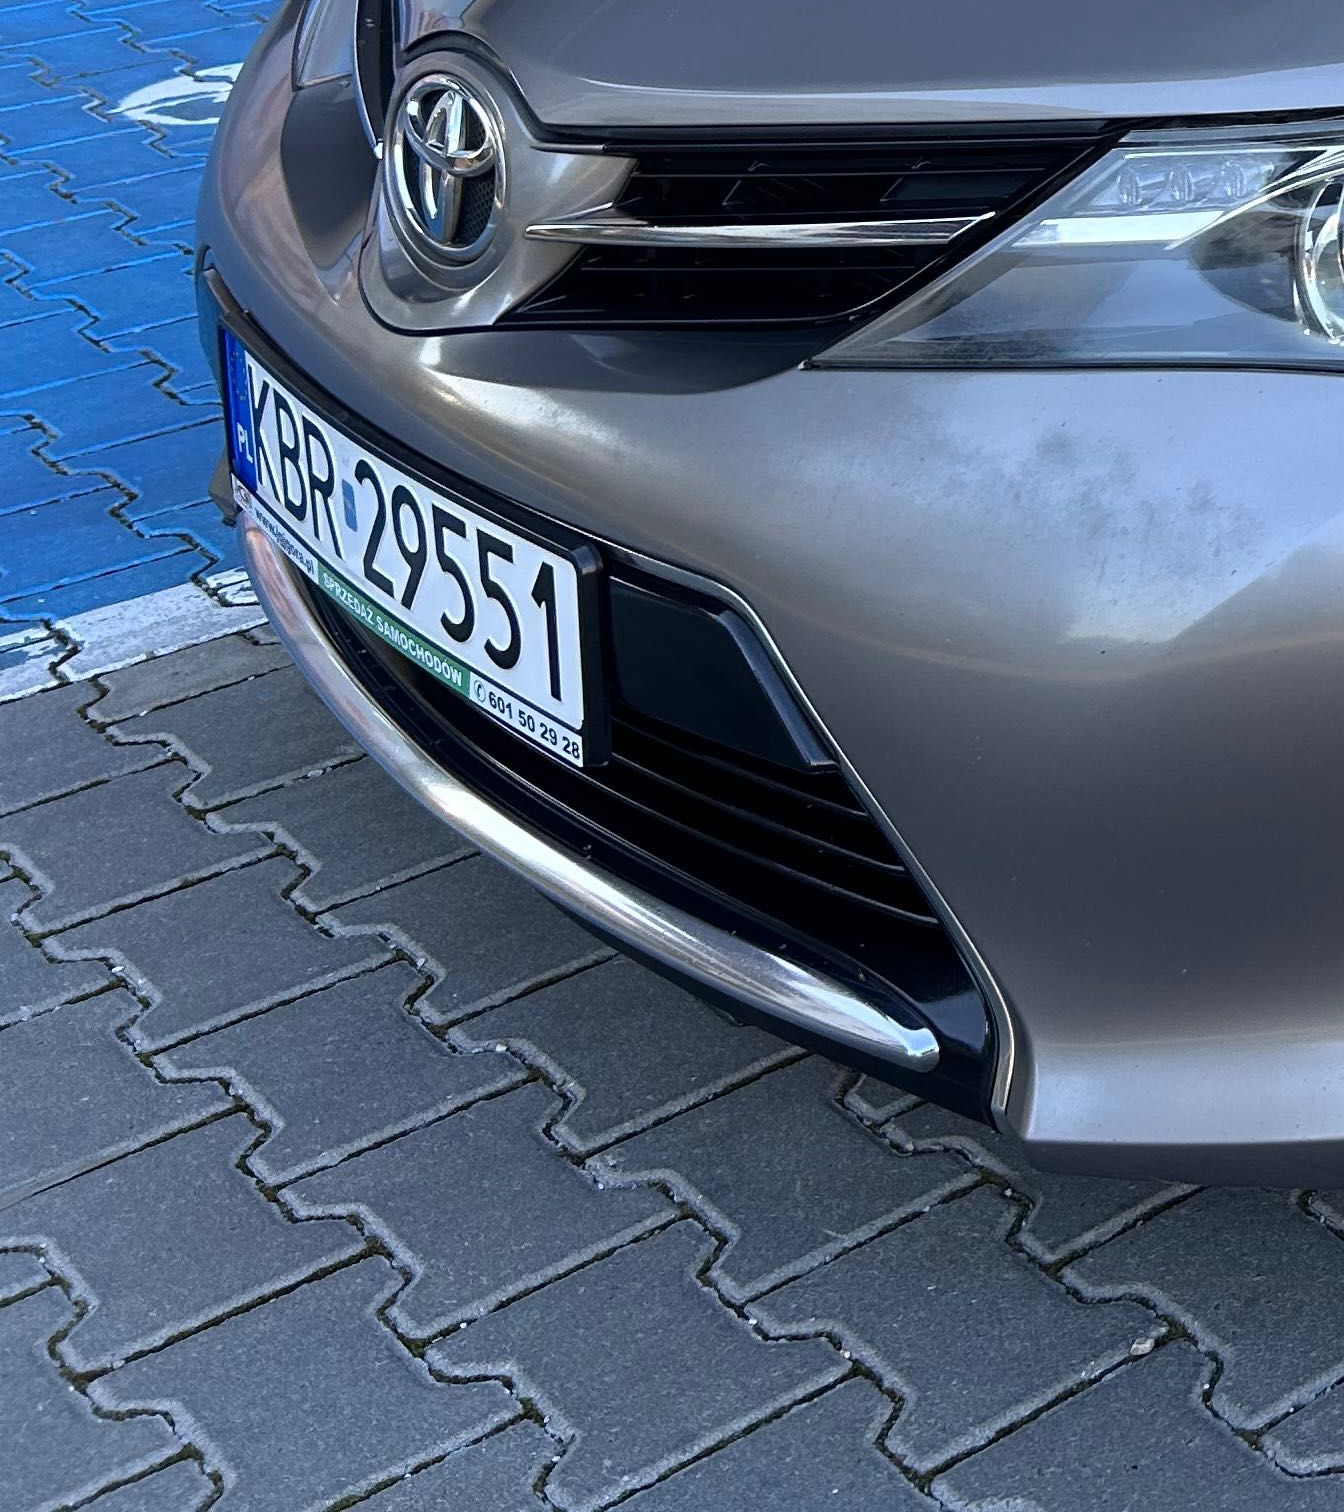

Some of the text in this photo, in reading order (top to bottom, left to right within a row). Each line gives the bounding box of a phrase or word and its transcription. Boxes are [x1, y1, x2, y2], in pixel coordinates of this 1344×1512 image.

[236, 421, 254, 464] PL
[247, 363, 562, 702] KBR 29551
[322, 571, 462, 688] SPRZEDAŻ SAMOCHODÓW
[488, 690, 580, 760] 601 50 29 28
